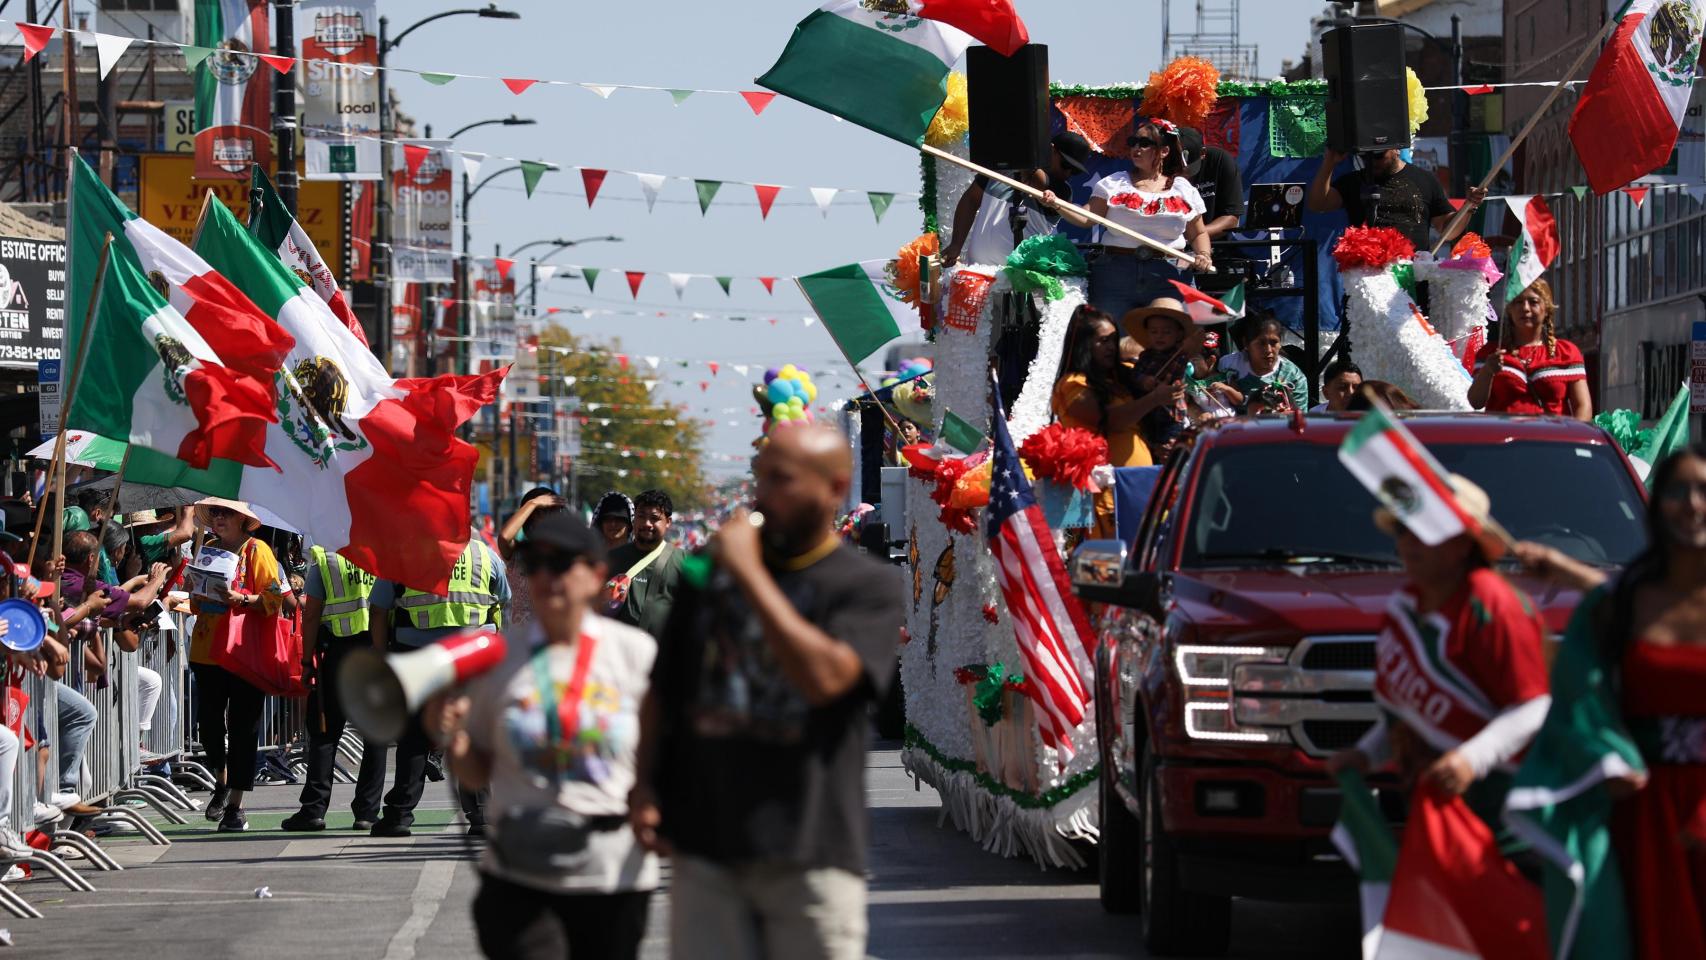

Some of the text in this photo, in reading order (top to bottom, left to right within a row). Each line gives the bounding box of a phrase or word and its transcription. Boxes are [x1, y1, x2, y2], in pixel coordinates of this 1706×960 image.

[308, 58, 375, 82] Shop
[337, 102, 376, 114] Local
[398, 186, 450, 207] Shop
[419, 222, 450, 231] Local
[1, 240, 36, 260] ESTATE
[0, 312, 29, 329] TEN
